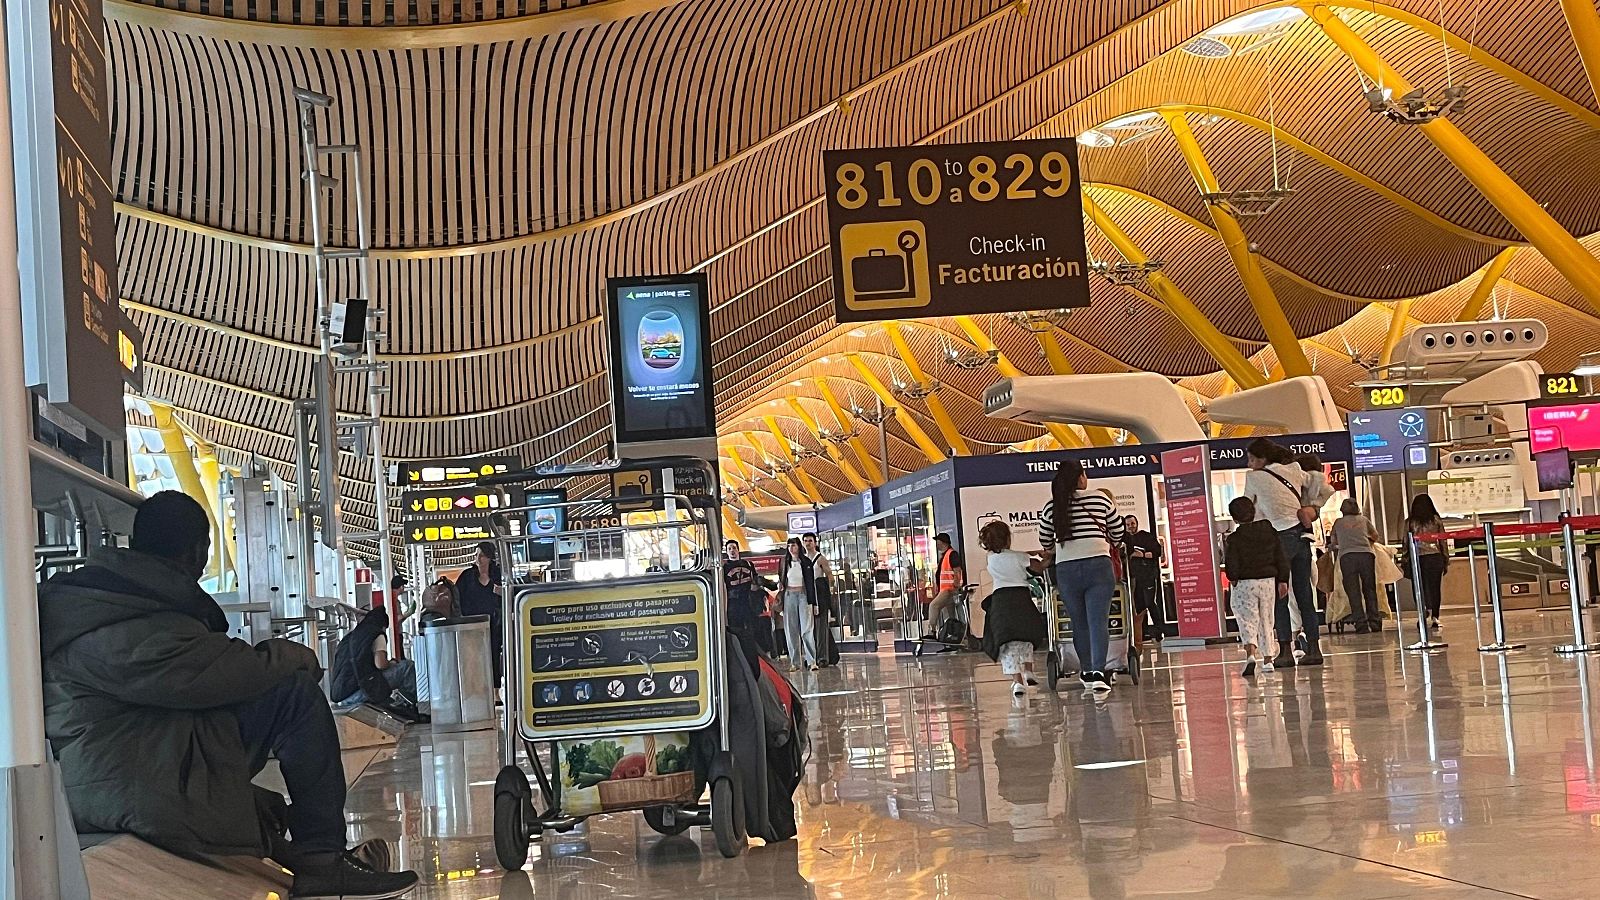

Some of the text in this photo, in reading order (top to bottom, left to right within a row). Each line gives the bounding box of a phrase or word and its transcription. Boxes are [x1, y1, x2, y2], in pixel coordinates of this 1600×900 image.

[836, 151, 1072, 209] 810 to a 829
[969, 233, 1046, 255] Check-in
[938, 256, 1081, 285] Facturación
[1547, 377, 1579, 394] 821
[1370, 387, 1405, 406] 820
[1543, 411, 1577, 420] IBERIA
[1219, 449, 1244, 459] AND
[1289, 443, 1326, 454] STORE
[1026, 455, 1147, 472] TIEND EL VIAJERO
[674, 476, 703, 485] heck-in
[1009, 510, 1043, 522] MALE
[546, 606, 566, 614] Carro
[567, 605, 584, 614] para
[600, 601, 633, 610] exclusivo
[645, 597, 680, 608] pasajeros
[552, 614, 574, 623] Trolley
[585, 611, 615, 620] exclusive
[637, 607, 674, 618] passengers
